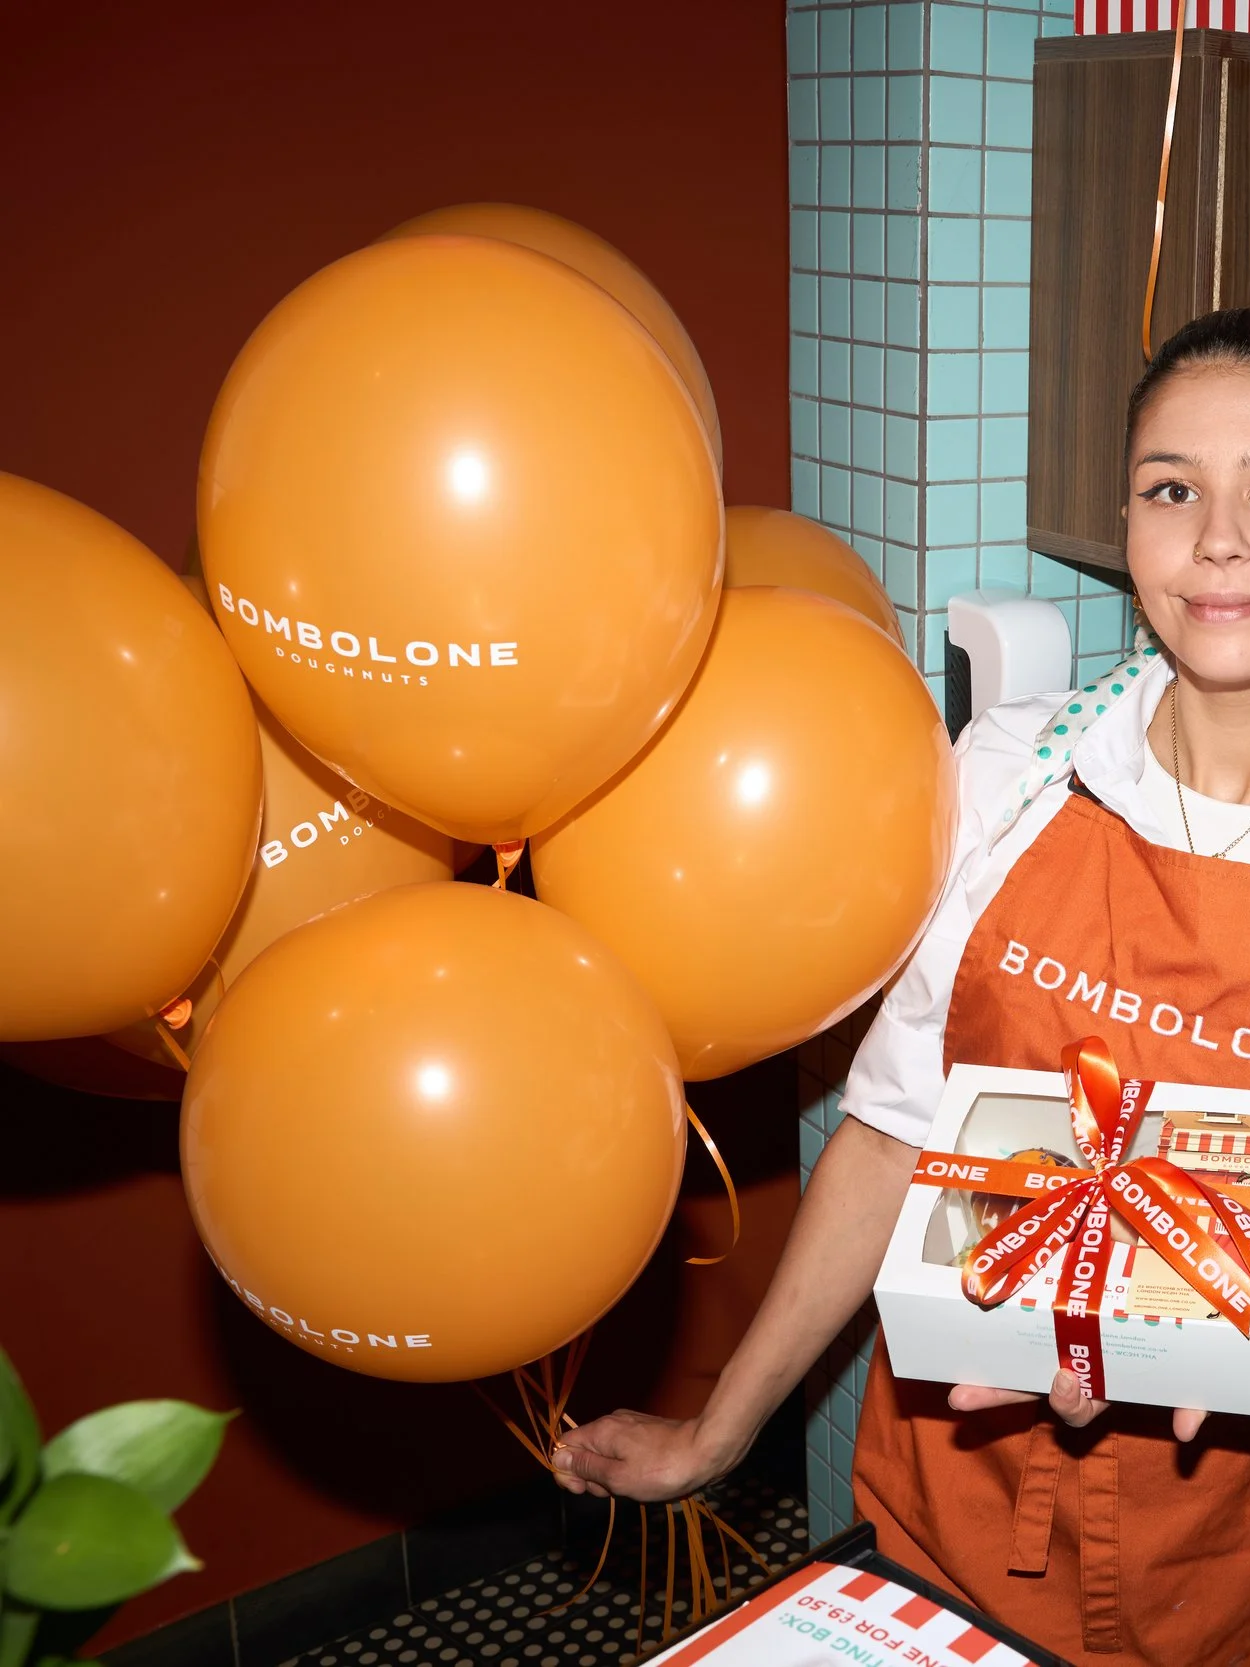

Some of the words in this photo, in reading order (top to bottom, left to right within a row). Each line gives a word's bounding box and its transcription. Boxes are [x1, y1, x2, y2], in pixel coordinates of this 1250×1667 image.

[219, 583, 518, 667] BOMBOLONE
[276, 647, 428, 686] DOUGHNUTS
[260, 787, 371, 869] BOMB
[220, 1266, 433, 1348] BOLONE
[1104, 1285, 1130, 1295] LO
[778, 1611, 839, 1643] BOX:
[797, 1595, 856, 1626] £9.50
[854, 1619, 901, 1651] FOR
